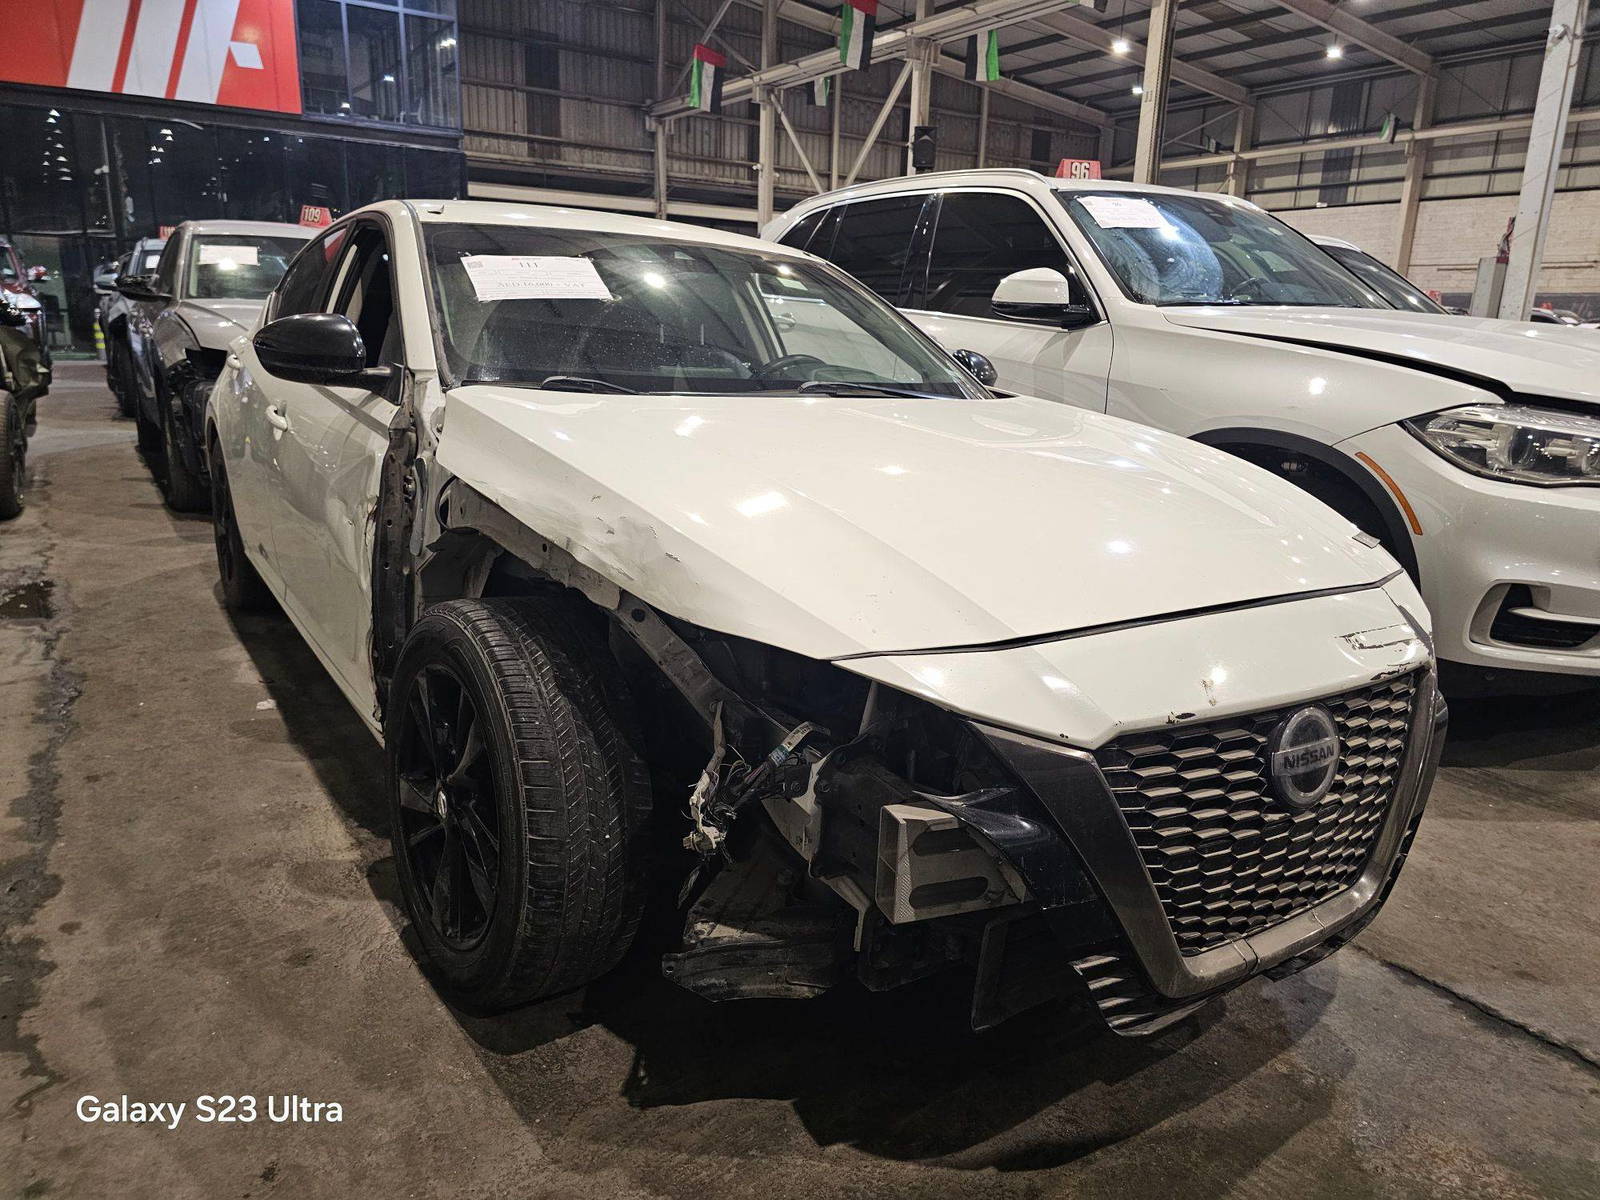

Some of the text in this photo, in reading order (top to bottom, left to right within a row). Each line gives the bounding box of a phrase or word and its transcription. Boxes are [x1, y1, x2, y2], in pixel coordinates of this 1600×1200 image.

[1071, 162, 1089, 179] 96
[304, 207, 320, 223] 109
[1283, 744, 1335, 769] NISSAN
